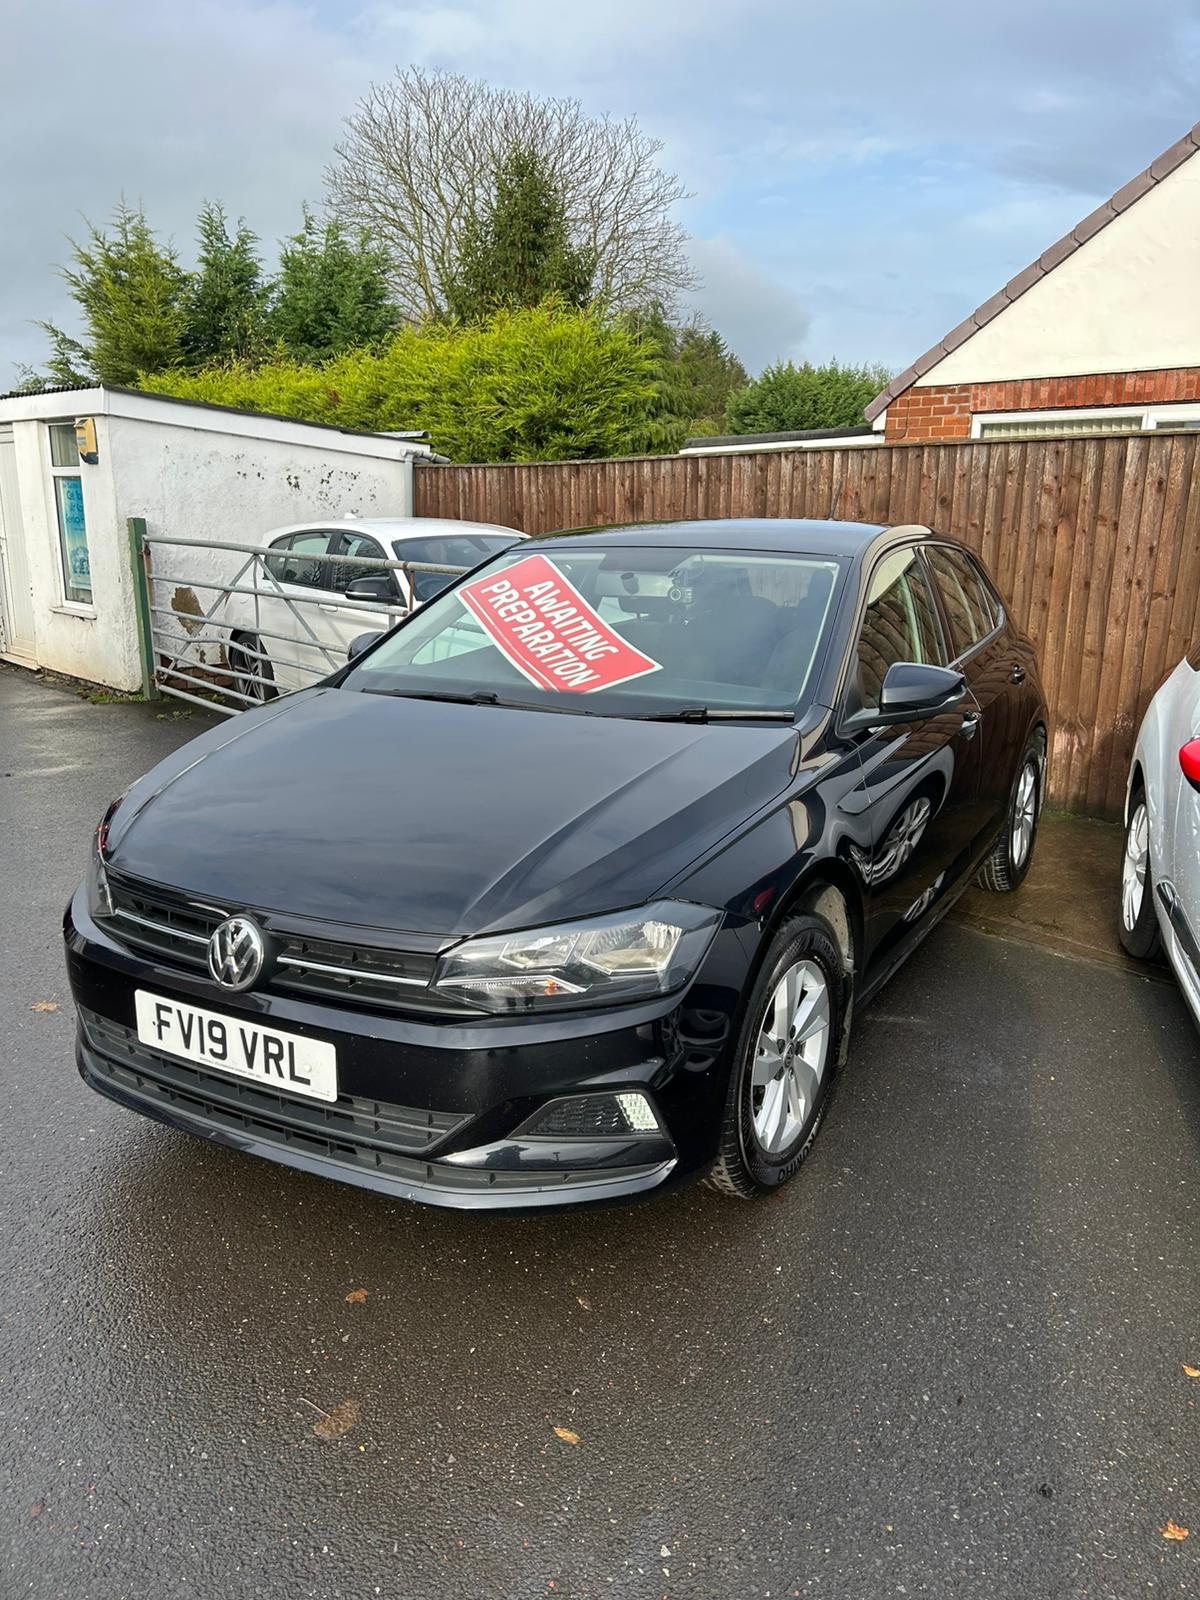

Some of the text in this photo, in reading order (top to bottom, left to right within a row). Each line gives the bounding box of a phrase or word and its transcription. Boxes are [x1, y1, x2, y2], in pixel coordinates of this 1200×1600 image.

[480, 579, 601, 687] PREPARATION
[523, 580, 619, 661] AWAITING
[155, 1002, 311, 1086] FV19 VRL
